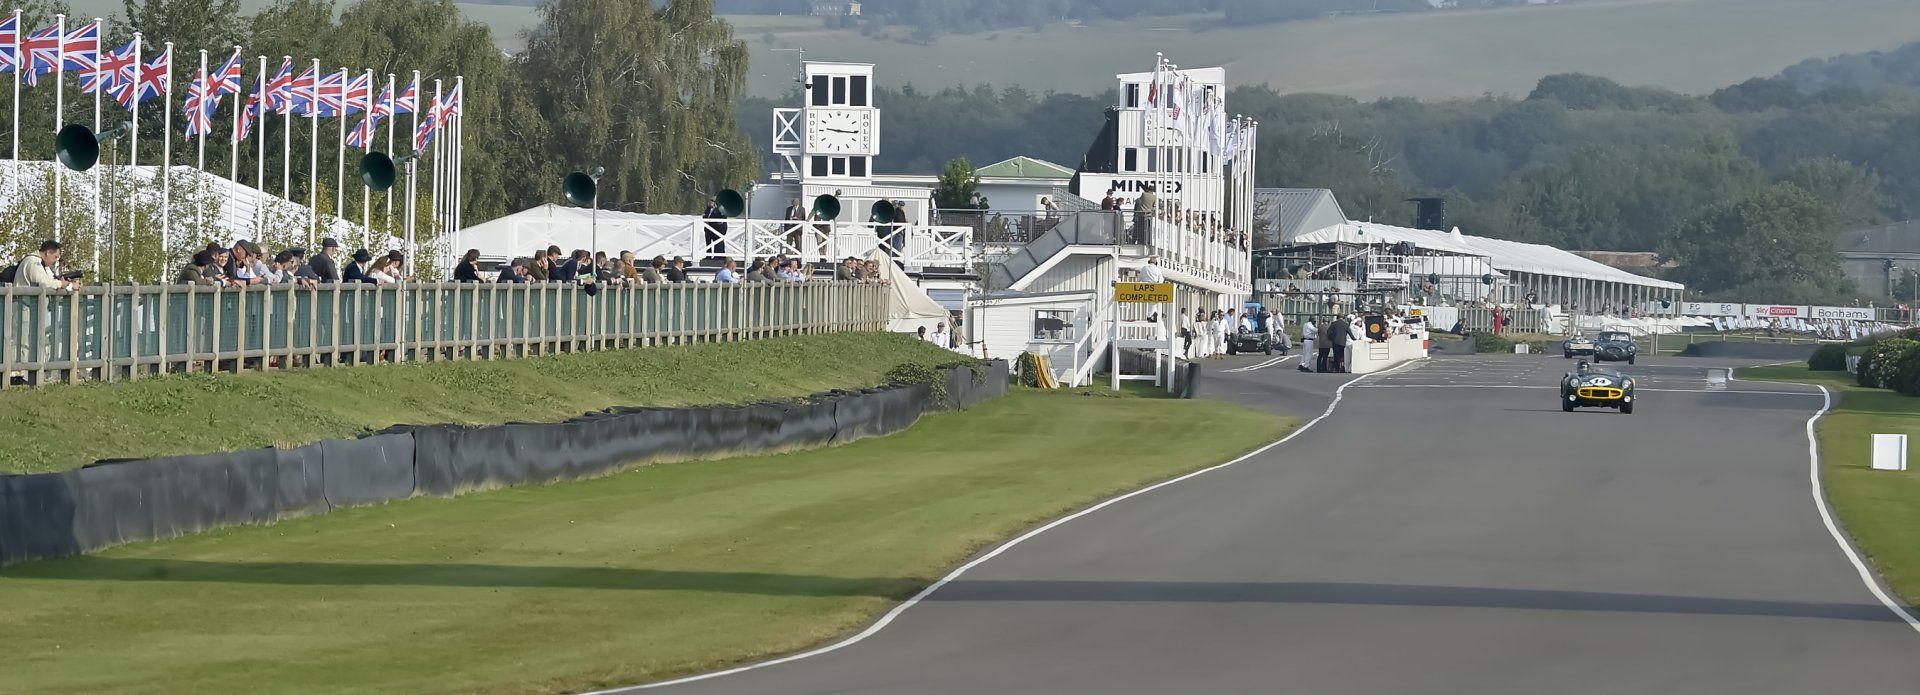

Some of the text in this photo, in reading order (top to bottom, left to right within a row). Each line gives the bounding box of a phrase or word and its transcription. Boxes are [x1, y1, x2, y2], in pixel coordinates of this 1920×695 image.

[1119, 293, 1169, 301] COMPLETED
[1756, 306, 1768, 314] sky
[1818, 309, 1868, 319] Bonhams
